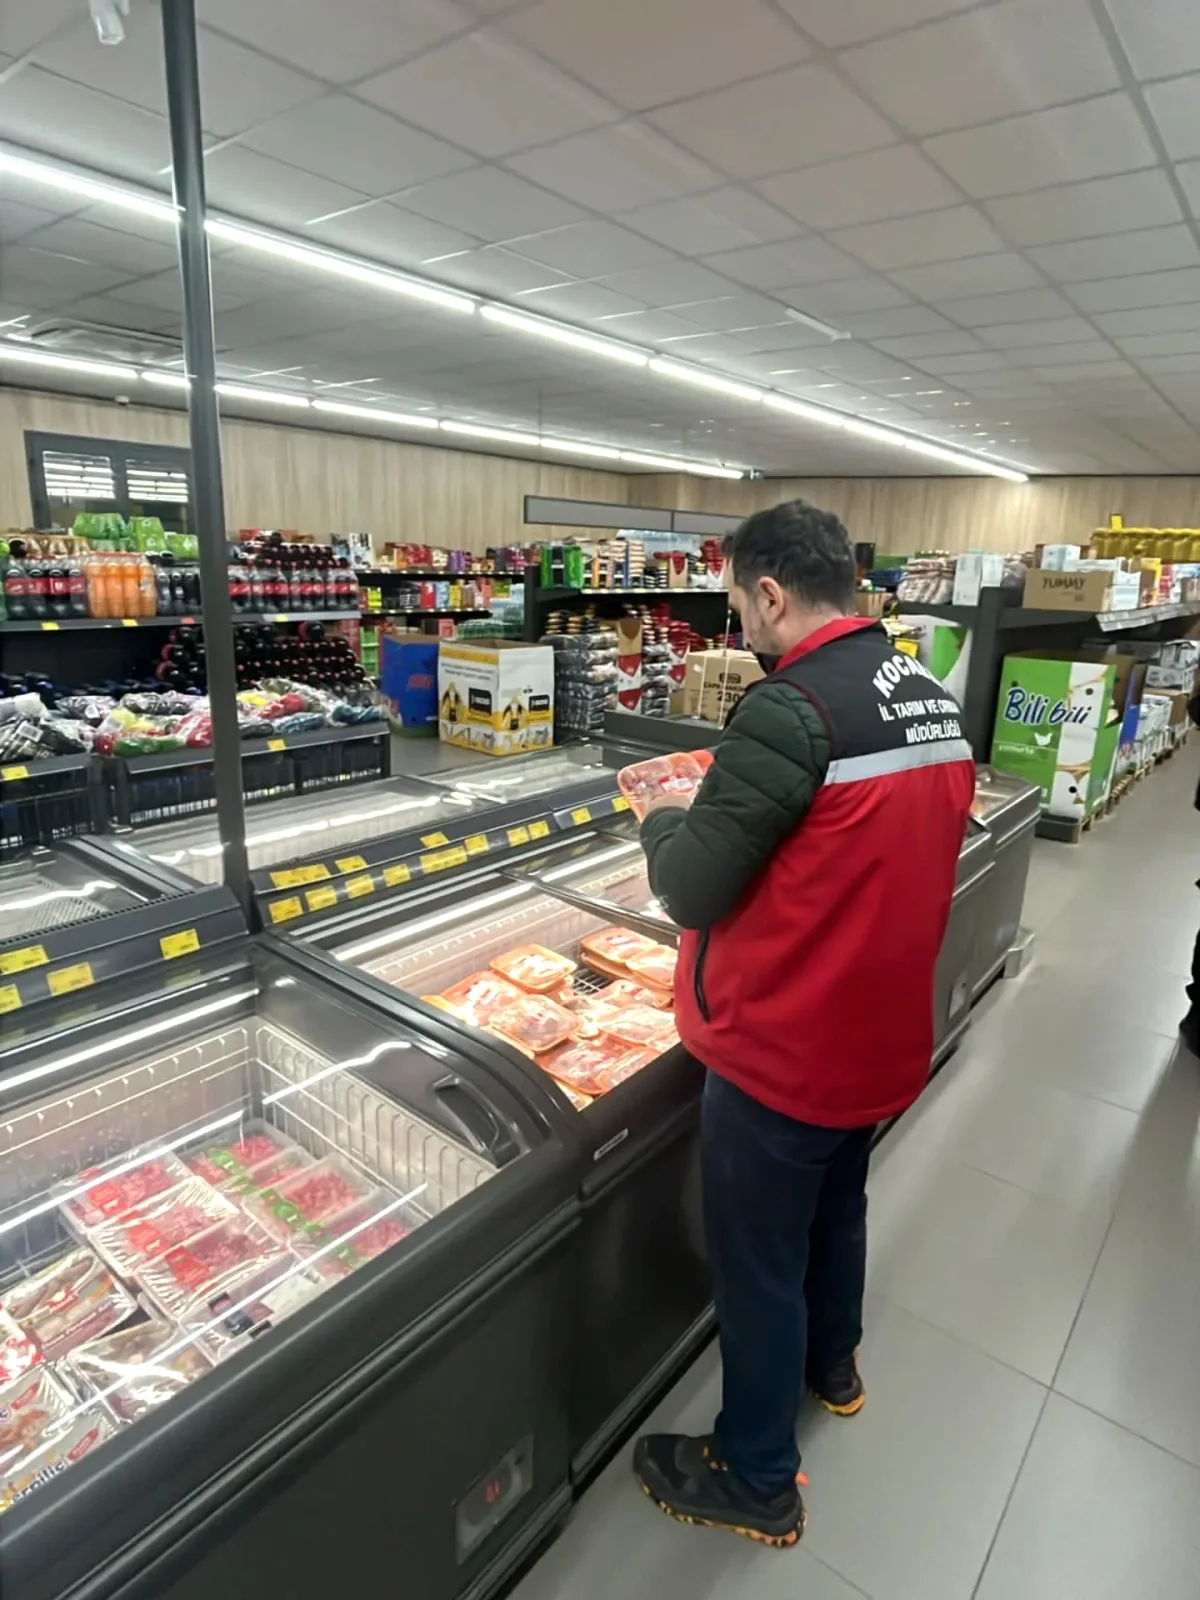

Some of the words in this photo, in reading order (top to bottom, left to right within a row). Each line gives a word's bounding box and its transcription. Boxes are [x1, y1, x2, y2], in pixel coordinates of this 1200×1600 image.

[877, 702, 895, 722] İL
[891, 699, 926, 719] TARIM
[924, 699, 939, 714] VE
[1005, 688, 1049, 725] Bili
[905, 719, 962, 744] MÜDÜRLÜĞÜ
